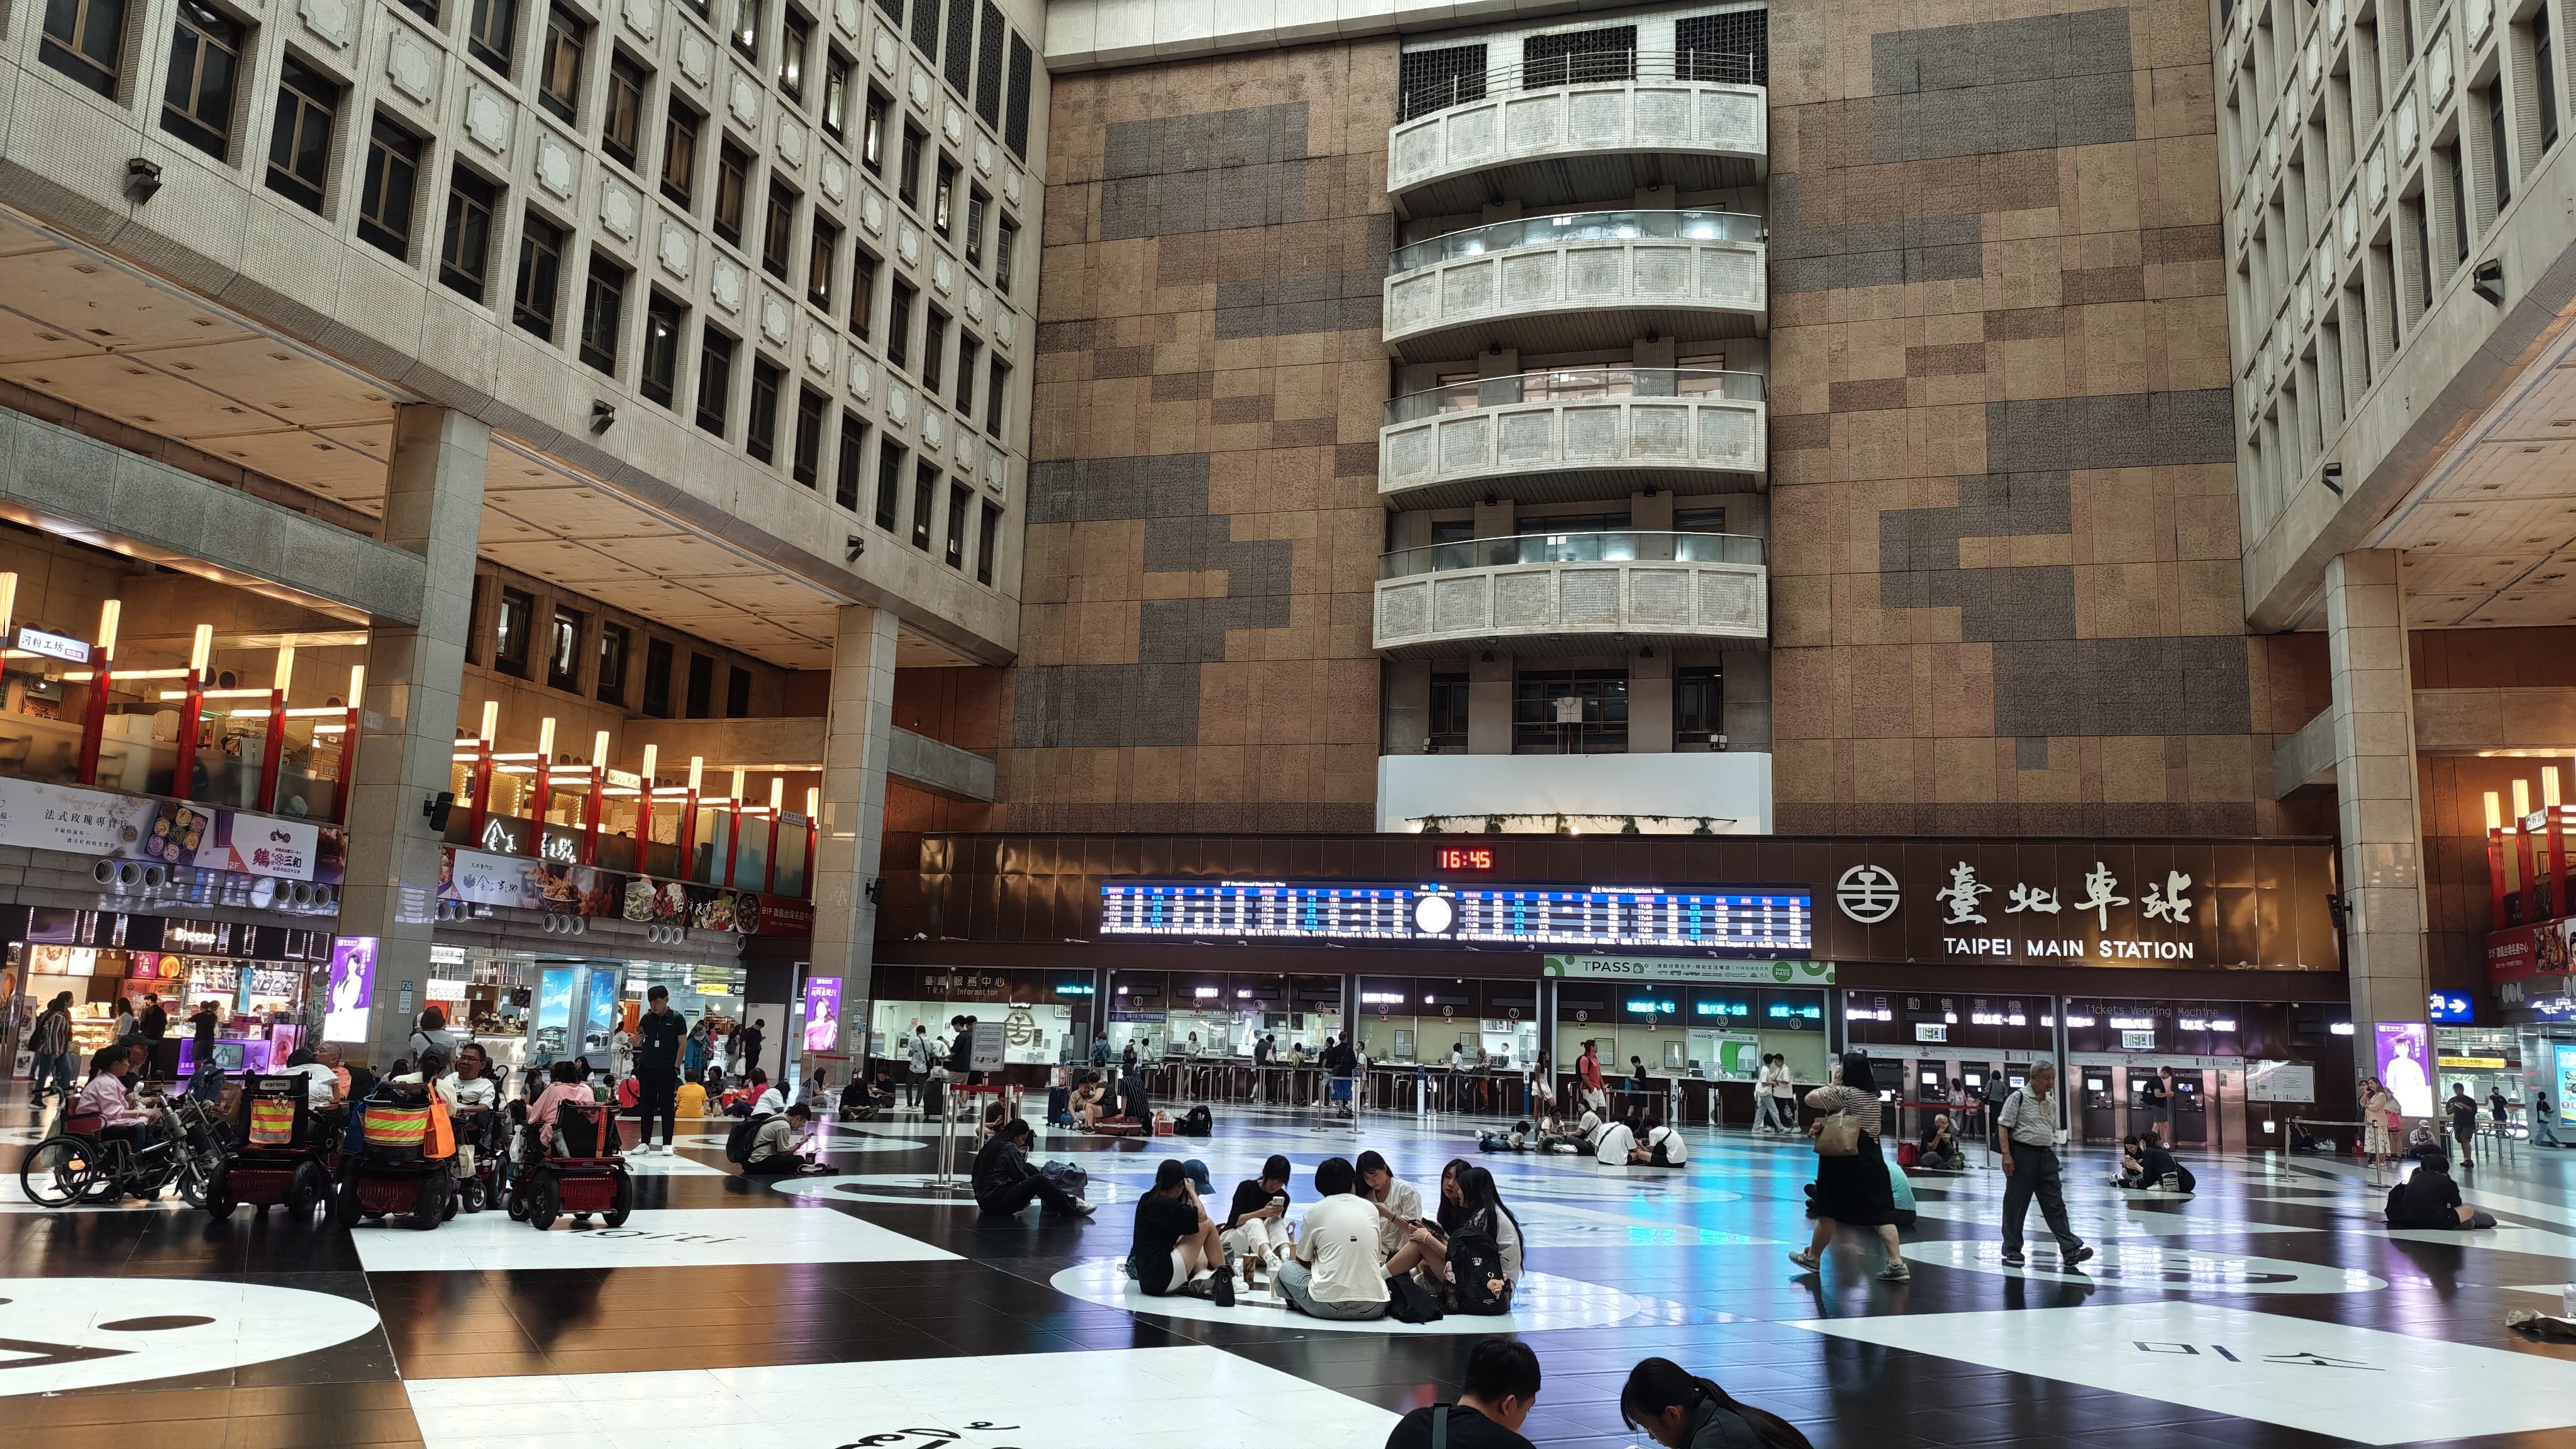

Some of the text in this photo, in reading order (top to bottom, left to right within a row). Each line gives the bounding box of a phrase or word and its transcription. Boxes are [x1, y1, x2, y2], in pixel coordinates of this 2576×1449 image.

[45, 809, 130, 830] 法式玫瑰專賣店
[229, 861, 240, 869] 2F
[1443, 851, 1491, 869] 16:45
[174, 928, 216, 943] Breeze
[1943, 937, 2194, 959] TAIPEI MAIN STATION
[1582, 961, 1630, 972] TPASS
[401, 982, 413, 991] F26
[957, 987, 999, 996] Information
[1874, 996, 2023, 1013] 自動售票機
[2085, 1004, 2219, 1018] Tickets Vending Machine
[568, 1228, 748, 1245] giti
[2132, 1341, 2386, 1371] 미소
